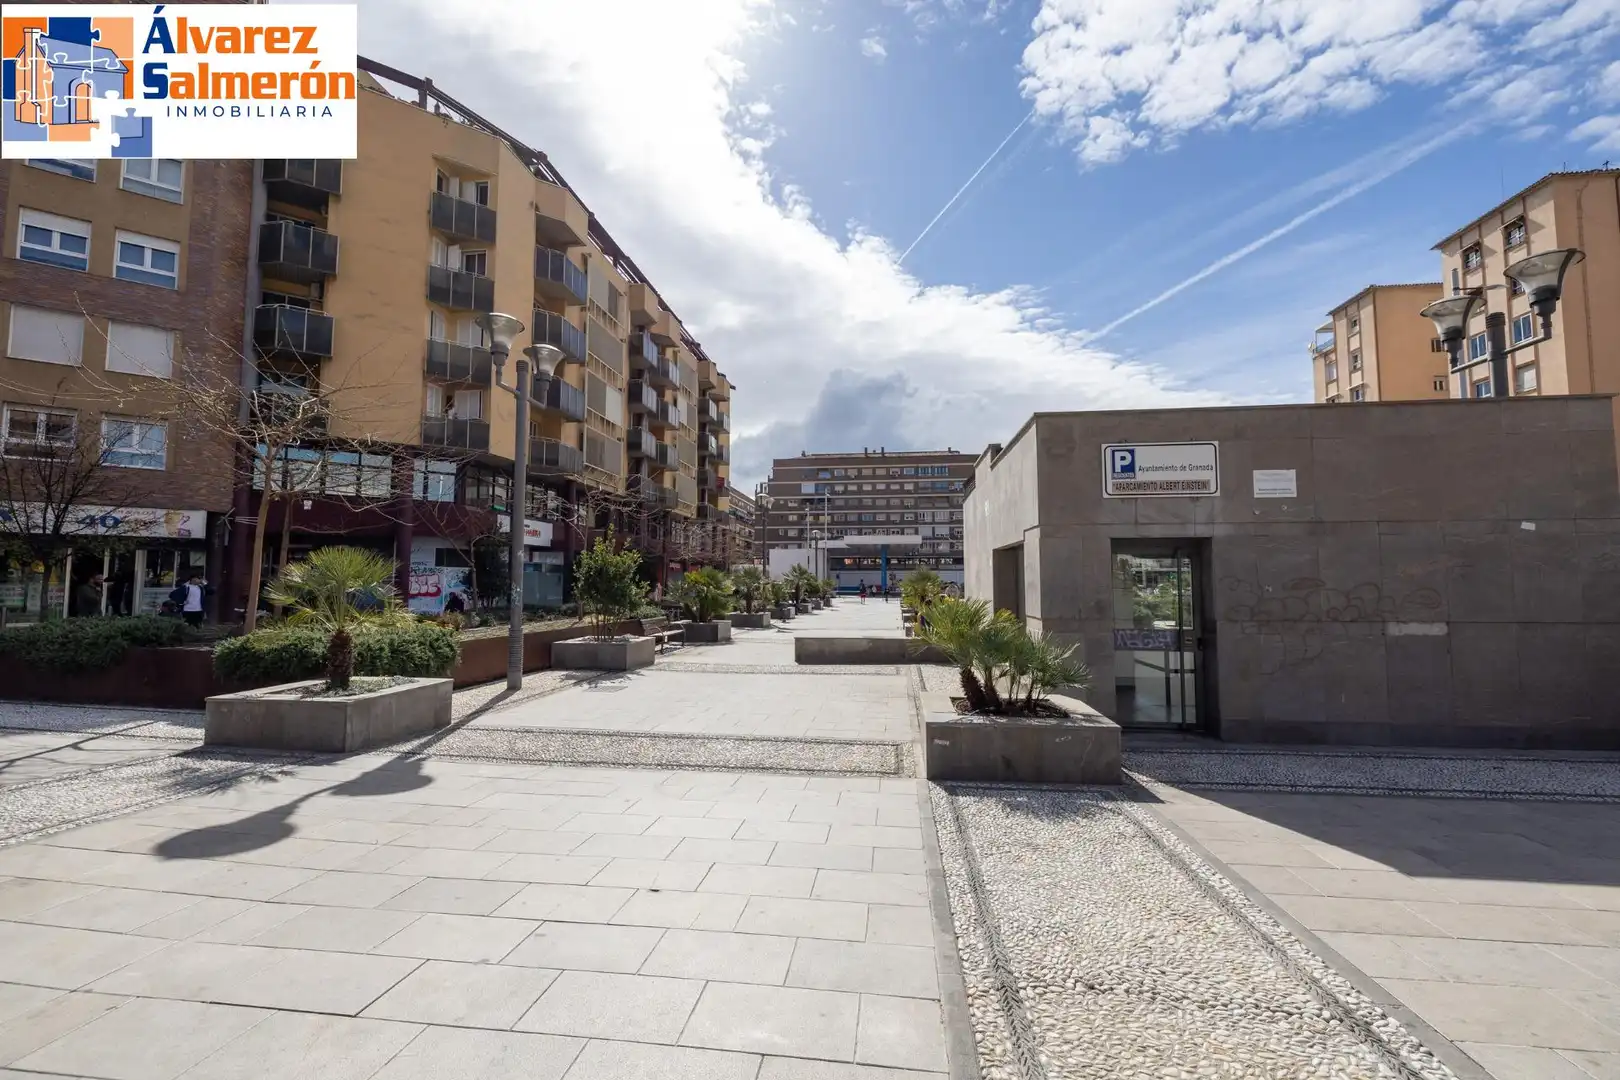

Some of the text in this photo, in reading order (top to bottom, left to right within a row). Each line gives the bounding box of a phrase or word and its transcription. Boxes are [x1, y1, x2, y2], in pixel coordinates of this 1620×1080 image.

[1114, 451, 1132, 472] P
[1138, 462, 1214, 473] Ayuntamiento de Granada
[1159, 481, 1180, 491] ALBERT
